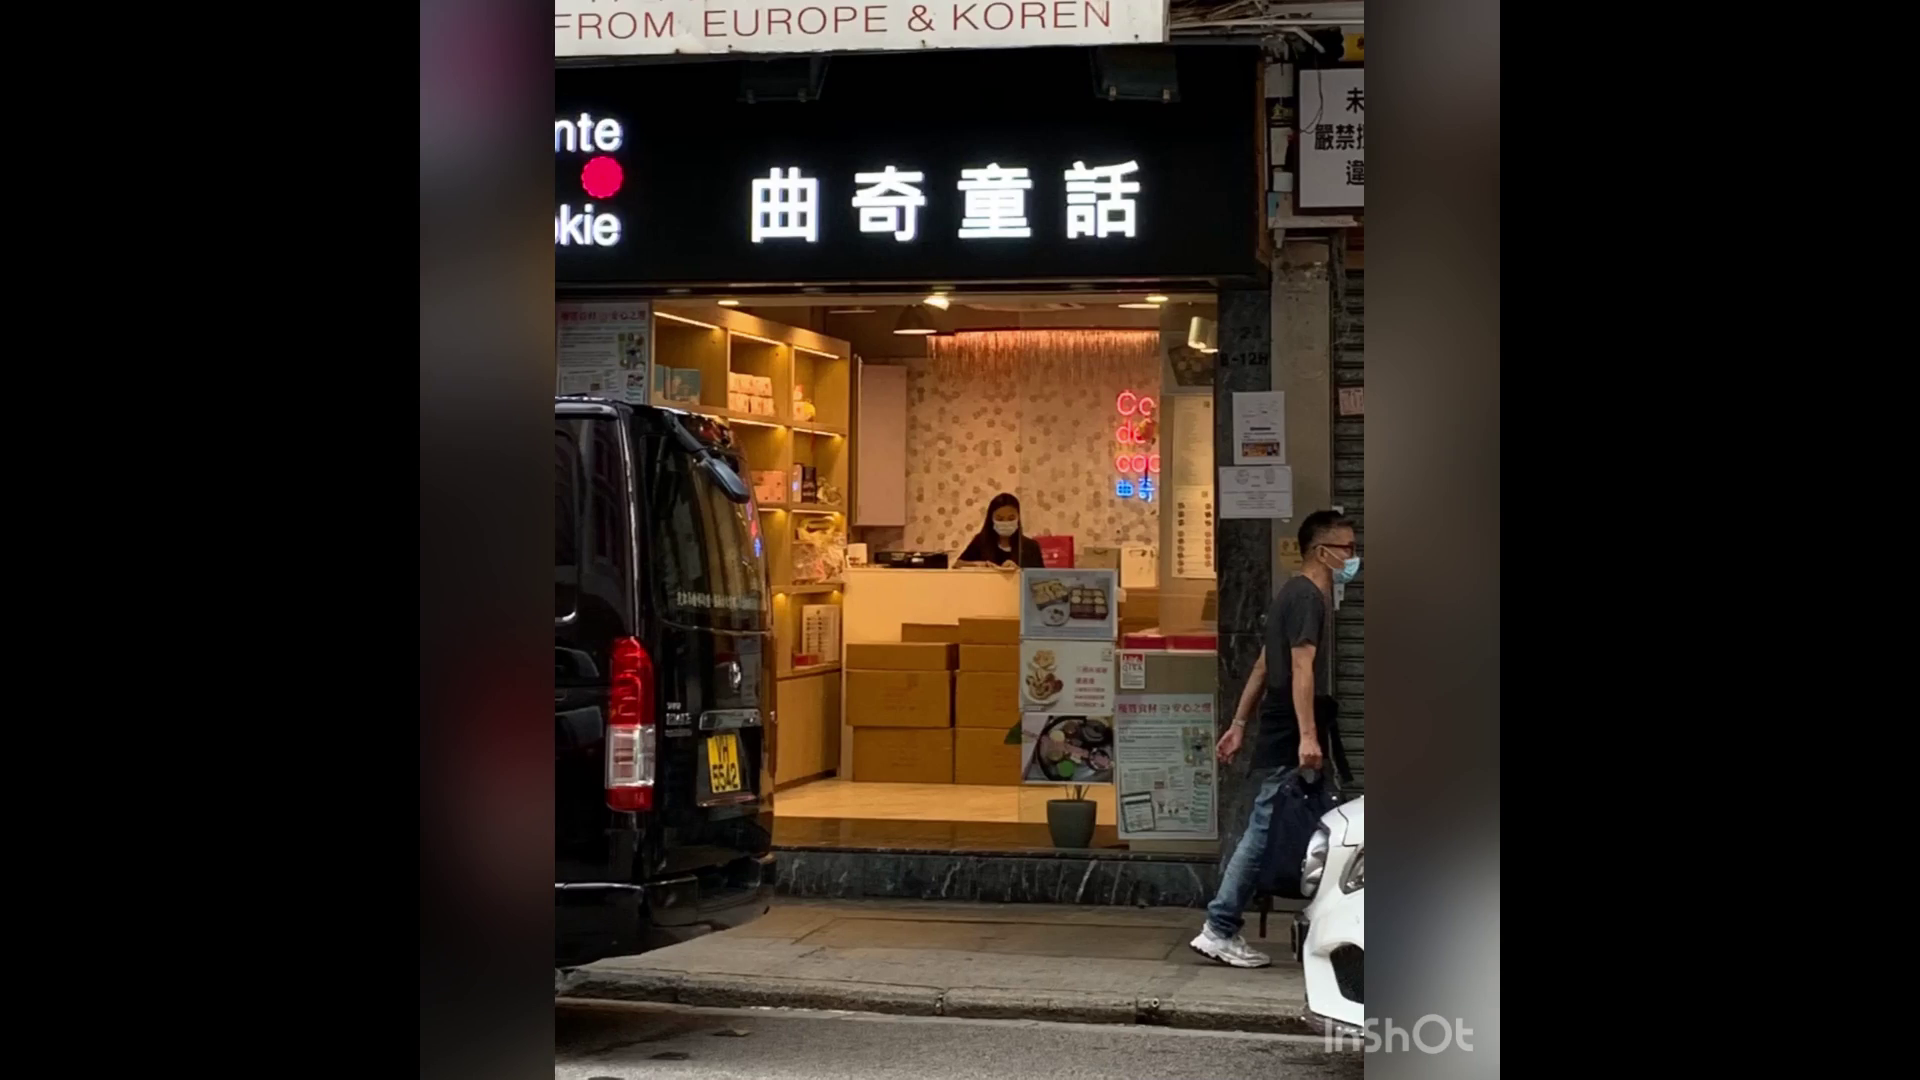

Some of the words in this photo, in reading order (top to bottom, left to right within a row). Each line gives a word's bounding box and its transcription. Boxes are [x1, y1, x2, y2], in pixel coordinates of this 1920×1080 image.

[703, 5, 889, 37] EUROPE
[907, 3, 935, 32] &
[952, 0, 1111, 31] KOREN
[750, 160, 1141, 244] 曲奇童話
[555, 203, 622, 247] kie
[1116, 478, 1155, 502] 曲奇
[711, 763, 740, 790] 5542
